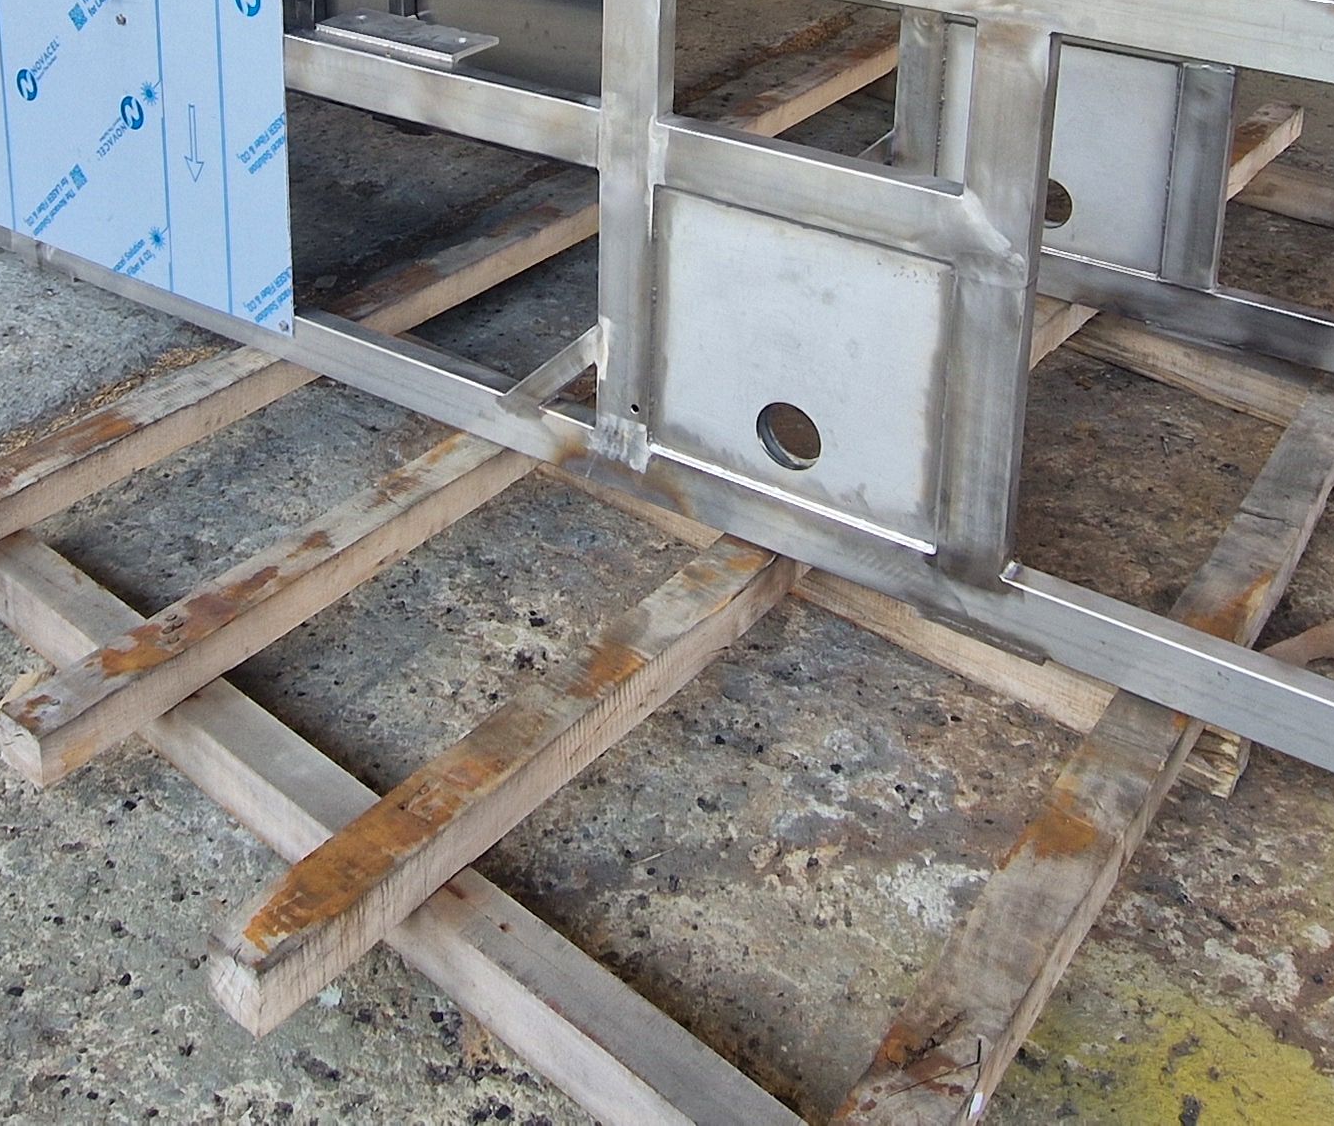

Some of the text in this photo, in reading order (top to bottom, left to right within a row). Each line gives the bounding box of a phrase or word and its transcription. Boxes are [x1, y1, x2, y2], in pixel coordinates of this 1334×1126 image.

[89, 5, 97, 16] for
[30, 39, 60, 74] NOVACEL
[96, 124, 127, 158] NOVACEL
